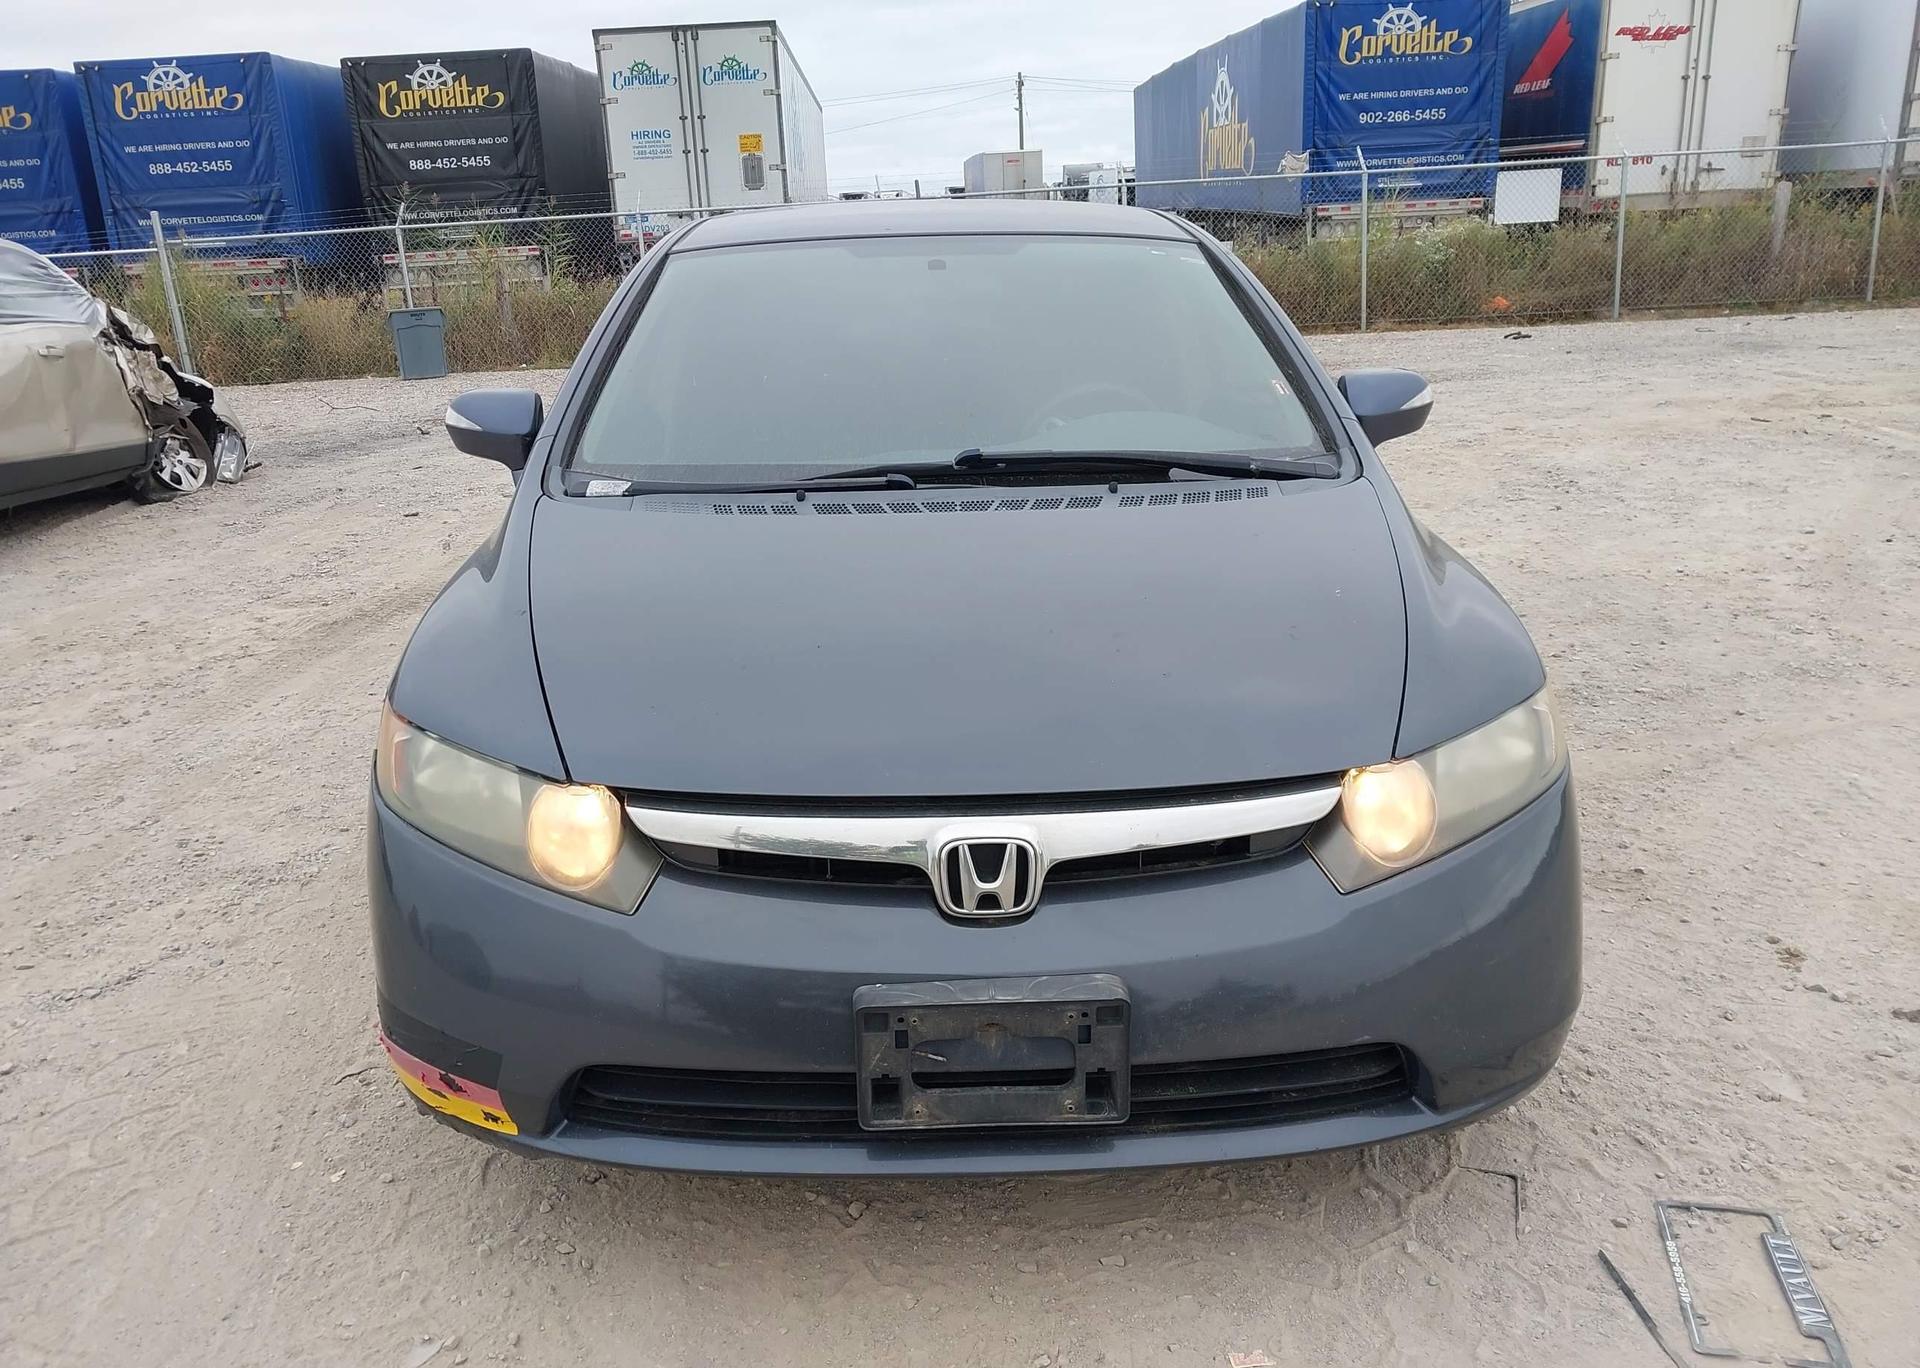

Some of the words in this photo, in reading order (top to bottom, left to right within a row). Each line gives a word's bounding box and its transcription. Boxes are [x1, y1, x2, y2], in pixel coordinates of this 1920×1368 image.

[1615, 26, 1652, 36] RED
[1338, 18, 1473, 65] Corvette
[1362, 56, 1419, 65] LOGISTICS
[612, 68, 678, 91] Corvette
[702, 63, 768, 86] Corvette
[1338, 93, 1351, 101] WE
[1352, 92, 1369, 100] ARE
[1370, 90, 1398, 99] HIRING
[1399, 88, 1435, 98] DRIVERS
[1435, 87, 1453, 95] AND
[1454, 86, 1469, 94] O/O
[1513, 82, 1531, 95] RED
[1531, 78, 1552, 91] LEAF
[112, 75, 244, 120] Corvette
[377, 74, 505, 118] Corvette
[139, 111, 196, 120] LOGISTICS
[402, 109, 457, 118] LOGISTICS
[1359, 108, 1446, 124] 902-266-5455
[631, 129, 671, 140] HIRING
[124, 145, 137, 153] WE
[138, 144, 154, 153] ARE
[154, 143, 182, 152] HIRING
[183, 141, 216, 151] DRIVERS
[217, 140, 234, 149] AND
[235, 139, 250, 148] O/O
[385, 142, 399, 150] WE
[399, 141, 415, 149] ARE
[416, 140, 443, 149] HIRING
[443, 138, 477, 147] DRIVERS
[477, 137, 494, 145] AND
[494, 136, 509, 144] O/O
[10, 159, 25, 167] AND
[26, 158, 41, 166] O/O
[148, 160, 233, 175] 888-452-5455
[409, 155, 491, 171] 888-452-5455
[1336, 154, 1465, 168] WWW.ORVETTELOGISTICS.COM
[137, 213, 264, 226] WWCORVETTELOGISTICS.COM
